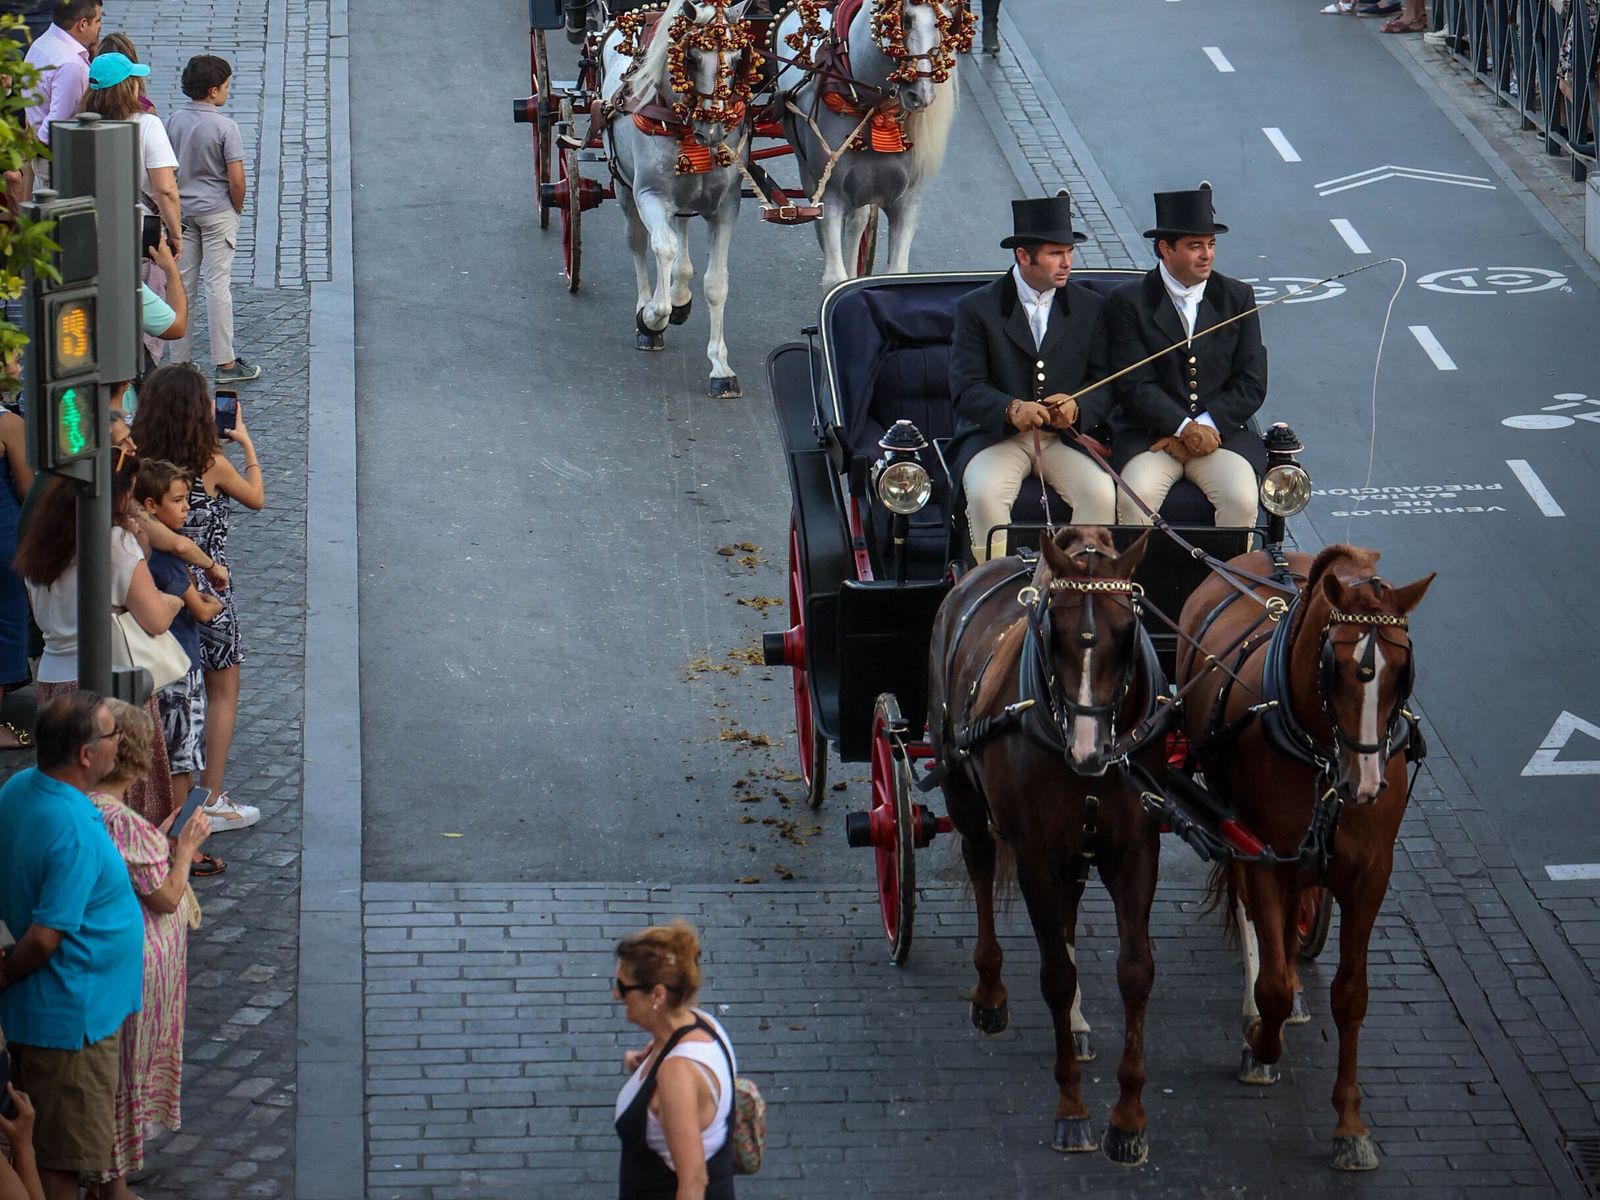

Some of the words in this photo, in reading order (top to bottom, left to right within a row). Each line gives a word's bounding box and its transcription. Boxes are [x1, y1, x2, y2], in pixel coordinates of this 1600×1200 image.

[1350, 492, 1457, 501] SALIDA
[1393, 500, 1432, 508] DE
[1331, 505, 1506, 517] VEHICULOS
